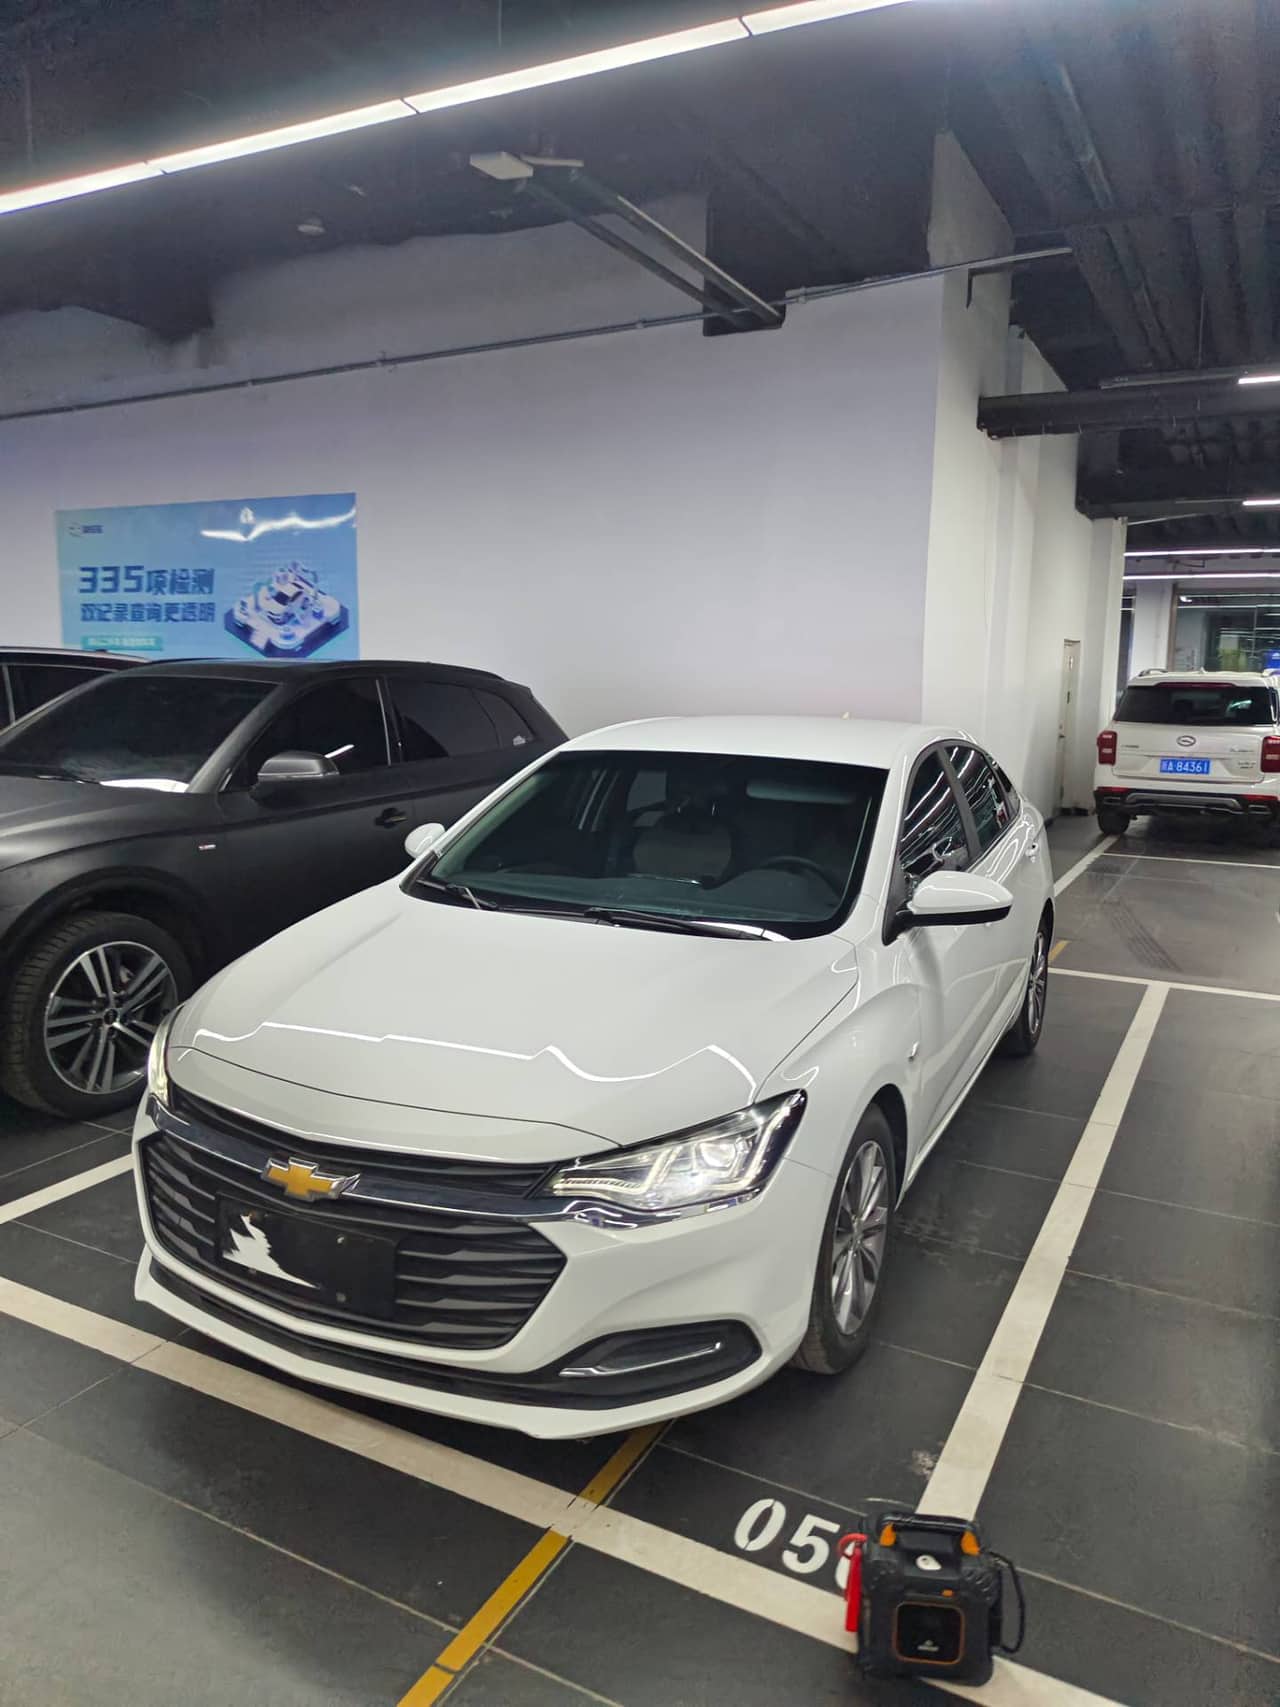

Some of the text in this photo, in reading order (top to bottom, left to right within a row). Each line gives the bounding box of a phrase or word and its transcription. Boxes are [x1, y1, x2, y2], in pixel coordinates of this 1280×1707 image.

[79, 565, 215, 595] 335项检测
[1161, 760, 1208, 773] A84361
